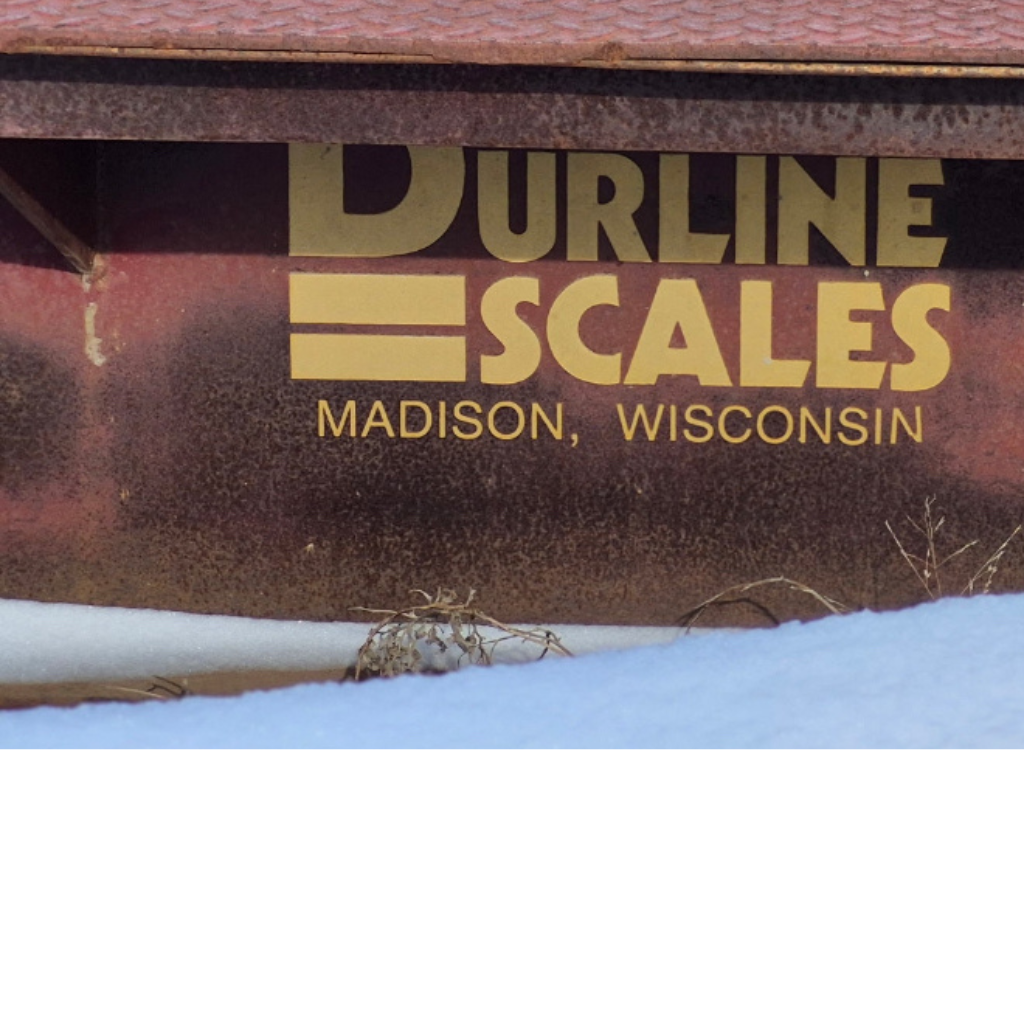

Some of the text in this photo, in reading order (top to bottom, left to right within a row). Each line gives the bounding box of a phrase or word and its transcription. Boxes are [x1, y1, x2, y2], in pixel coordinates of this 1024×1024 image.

[480, 275, 951, 391] SCALES
[317, 400, 924, 447] MADISON, WISCONSIN
